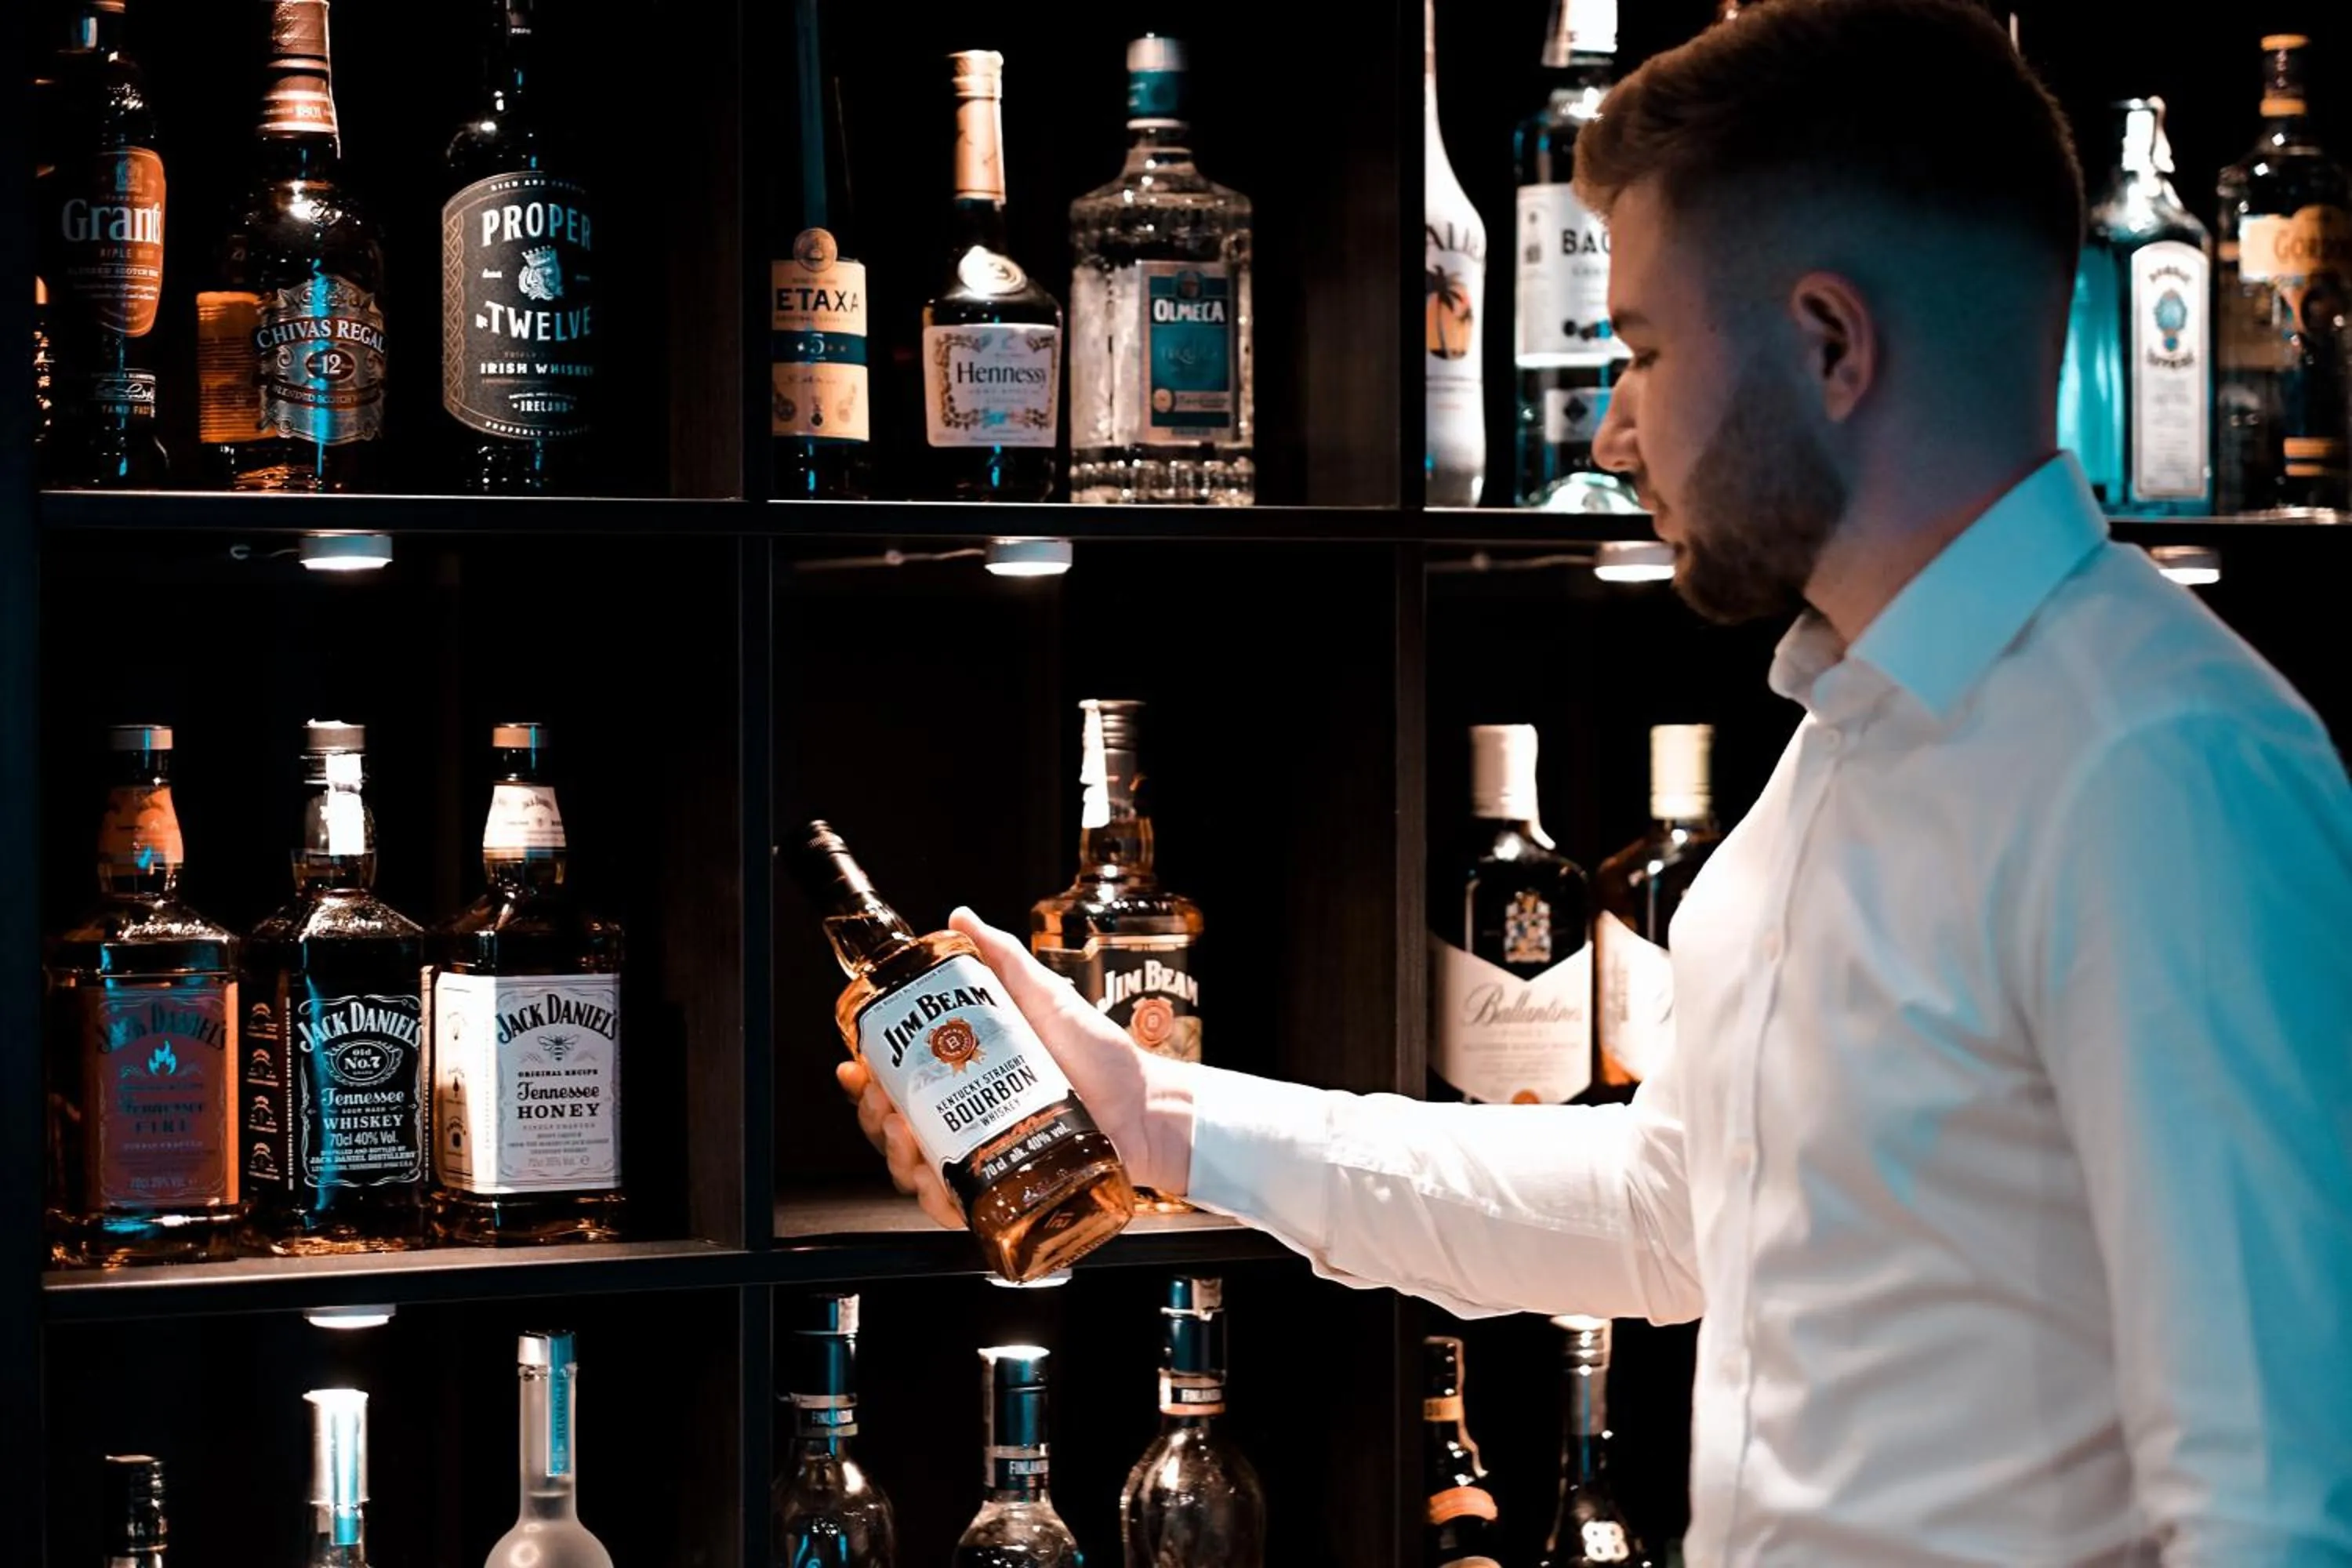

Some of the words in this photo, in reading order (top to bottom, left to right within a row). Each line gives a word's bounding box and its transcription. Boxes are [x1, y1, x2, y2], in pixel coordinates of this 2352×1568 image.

[481, 201, 591, 252] PROPER
[1562, 228, 1610, 256] BAC
[776, 288, 859, 312] ETAXA
[1152, 297, 1226, 324] OLMECA
[484, 299, 592, 343] TWELVE
[256, 318, 332, 350] CHIVAS
[336, 318, 386, 354] REGAL
[321, 354, 342, 375] 12
[480, 362, 528, 375] IRISH
[1096, 970, 1143, 1013] JIM
[1144, 959, 1199, 1007] BEAM
[296, 1011, 350, 1053] JACK
[495, 1003, 546, 1044] JACK
[883, 1010, 924, 1068] JIM
[915, 985, 998, 1022] BEAM
[343, 1055, 382, 1070] No.7
[351, 1047, 372, 1056] Old
[320, 1087, 405, 1107] Tennessee
[517, 1080, 601, 1102] Tennessee
[935, 1079, 982, 1114] KENTUCKY
[981, 1054, 1027, 1084] STRAIGHT
[517, 1102, 601, 1120] HONEY
[942, 1065, 1039, 1133] BOURBON
[979, 1098, 1022, 1127] WHISKEY
[322, 1114, 405, 1130] WHISKEY
[330, 1131, 354, 1147] 70cl
[354, 1131, 379, 1145] 40%
[1009, 1146, 1030, 1163] alk.
[1026, 1131, 1053, 1152] 40%
[1050, 1121, 1073, 1138] vol.
